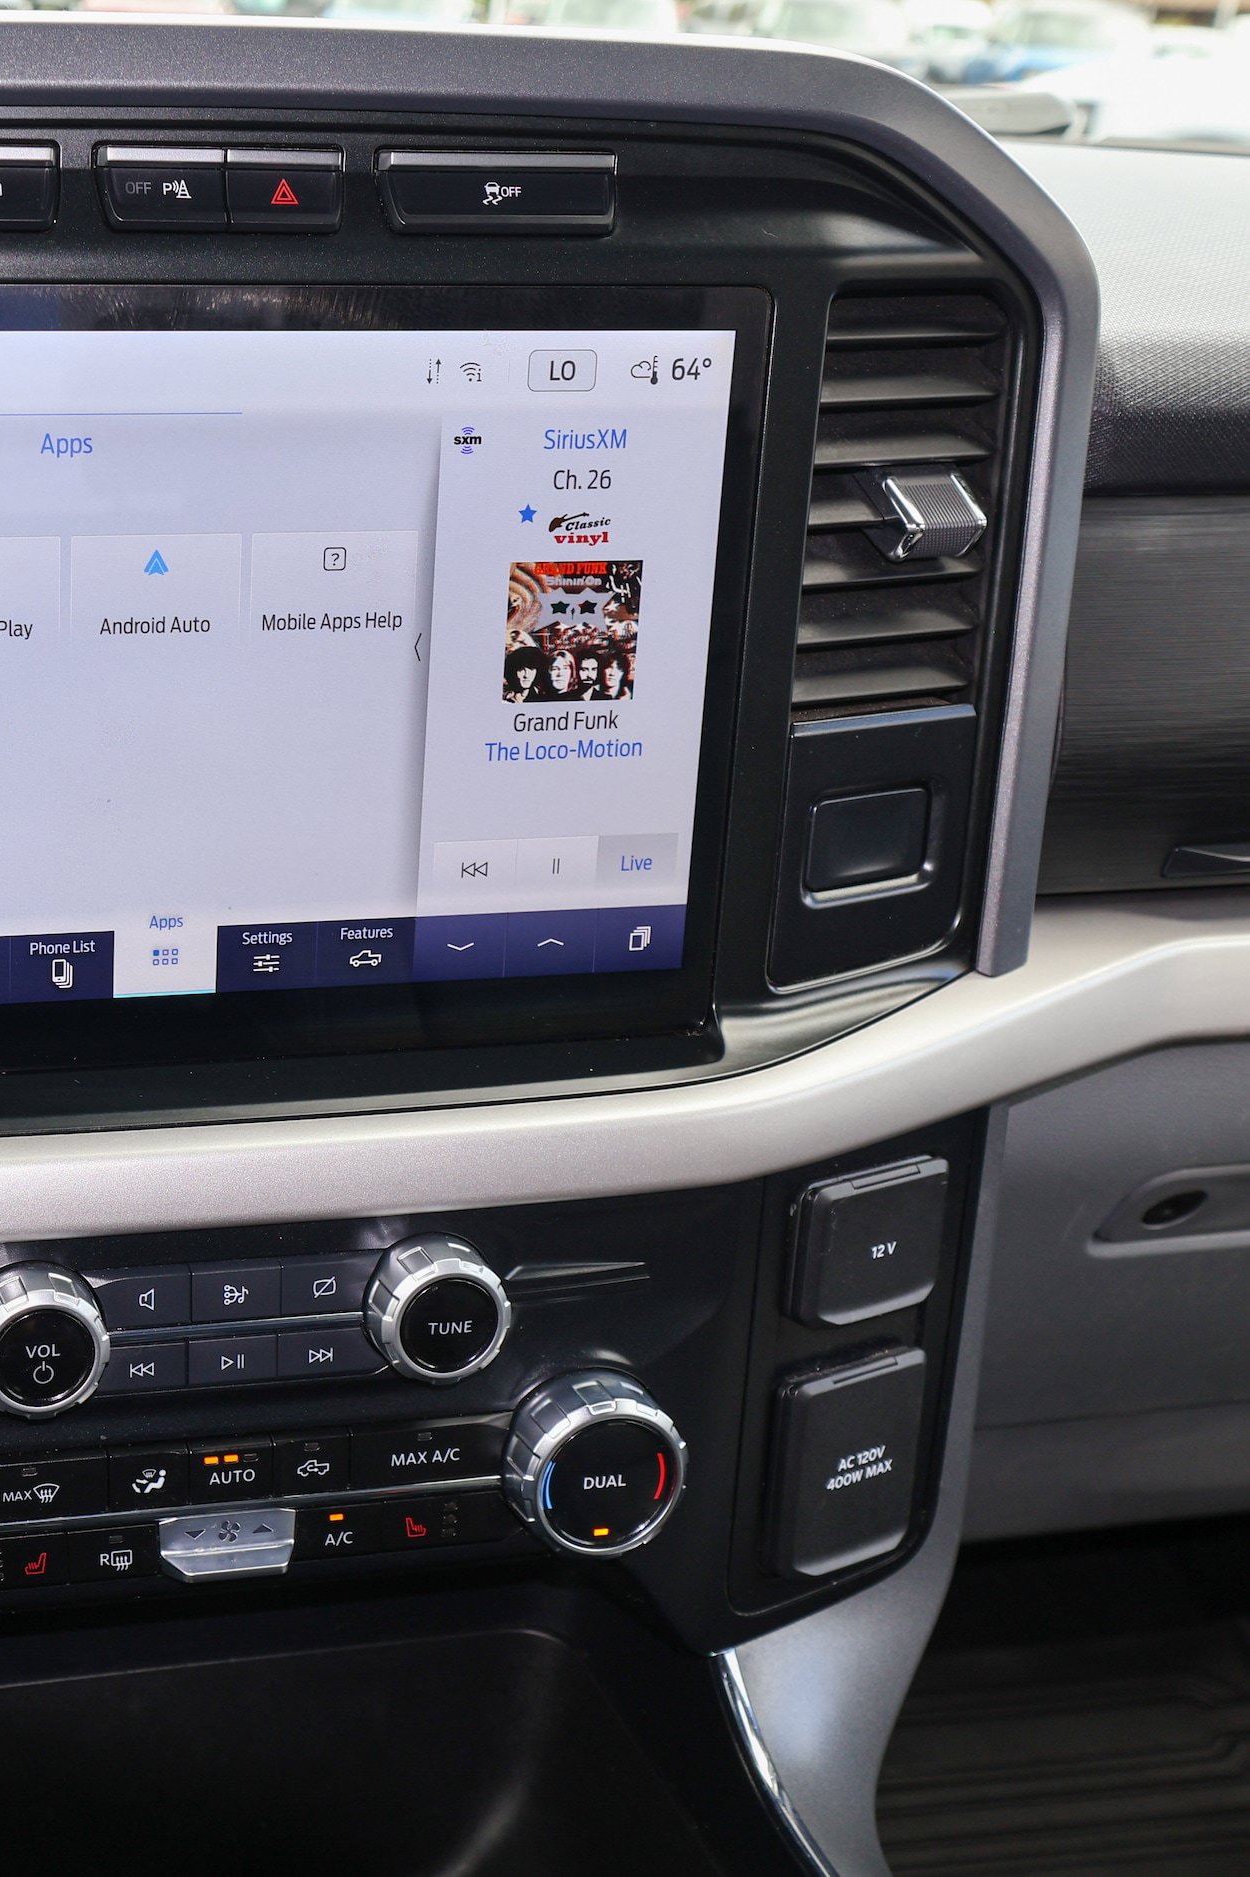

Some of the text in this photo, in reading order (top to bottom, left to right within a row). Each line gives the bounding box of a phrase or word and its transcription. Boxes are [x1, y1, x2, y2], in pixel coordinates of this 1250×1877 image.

[500, 186, 521, 197] OFF
[548, 359, 577, 382] LO
[670, 357, 713, 382] 64°
[39, 431, 94, 460] Apps
[453, 435, 482, 445] sxm
[542, 427, 628, 450] SiriusXM
[553, 469, 612, 491] Ch. 26
[565, 517, 611, 532] Classic
[553, 531, 609, 546] vinyl
[99, 616, 211, 635] Android Auto
[261, 609, 403, 633] Mobile Apps Help
[513, 711, 619, 733] Grand Funk
[485, 739, 643, 762] The Loco-Motion
[620, 853, 653, 872] Live
[149, 912, 184, 932] Apps
[241, 929, 293, 945] Settings
[339, 925, 393, 941] Features
[29, 939, 96, 956] Phone List
[870, 1240, 897, 1259] 12 V
[428, 1319, 474, 1336] TUNE
[25, 1343, 61, 1359] VOL
[390, 1448, 461, 1467] MAX A/C
[837, 1445, 886, 1473] AC 120V
[209, 1469, 256, 1486] AUTO
[583, 1473, 627, 1490] DUAL
[826, 1458, 893, 1490] 400W MAX
[2, 1489, 33, 1502] MAX
[325, 1532, 354, 1546] A/C
